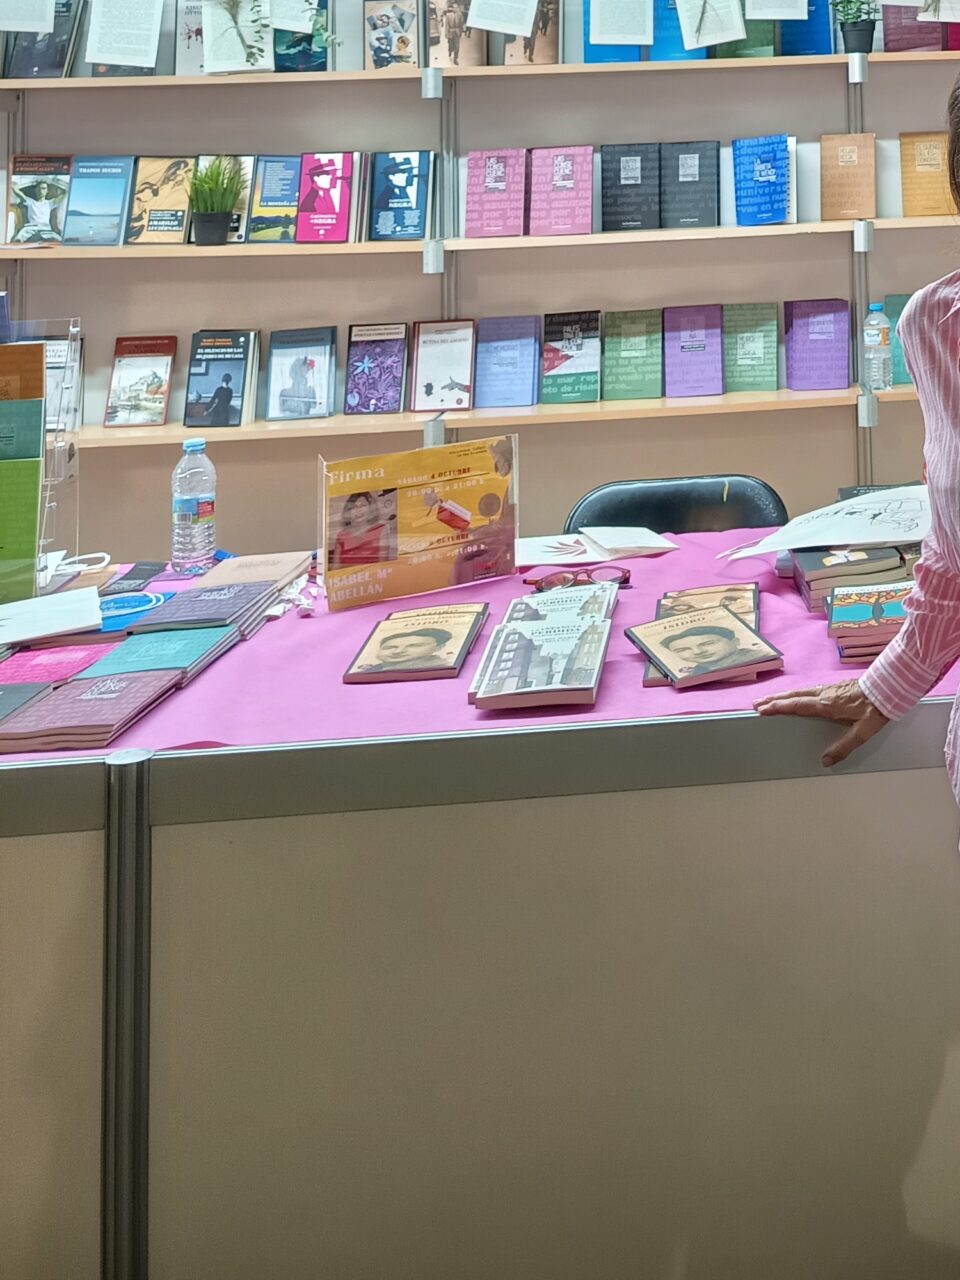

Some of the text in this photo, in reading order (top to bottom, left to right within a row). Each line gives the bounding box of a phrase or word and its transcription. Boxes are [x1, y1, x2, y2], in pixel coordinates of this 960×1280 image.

[740, 185, 788, 196] universo
[557, 376, 576, 384] mar
[560, 384, 572, 393] de
[328, 466, 385, 486] Firma
[437, 467, 471, 479] OCTUBRE
[328, 570, 372, 587] ISABEL
[329, 583, 383, 602] ABELLÁN
[663, 617, 706, 631] ISIDRO
